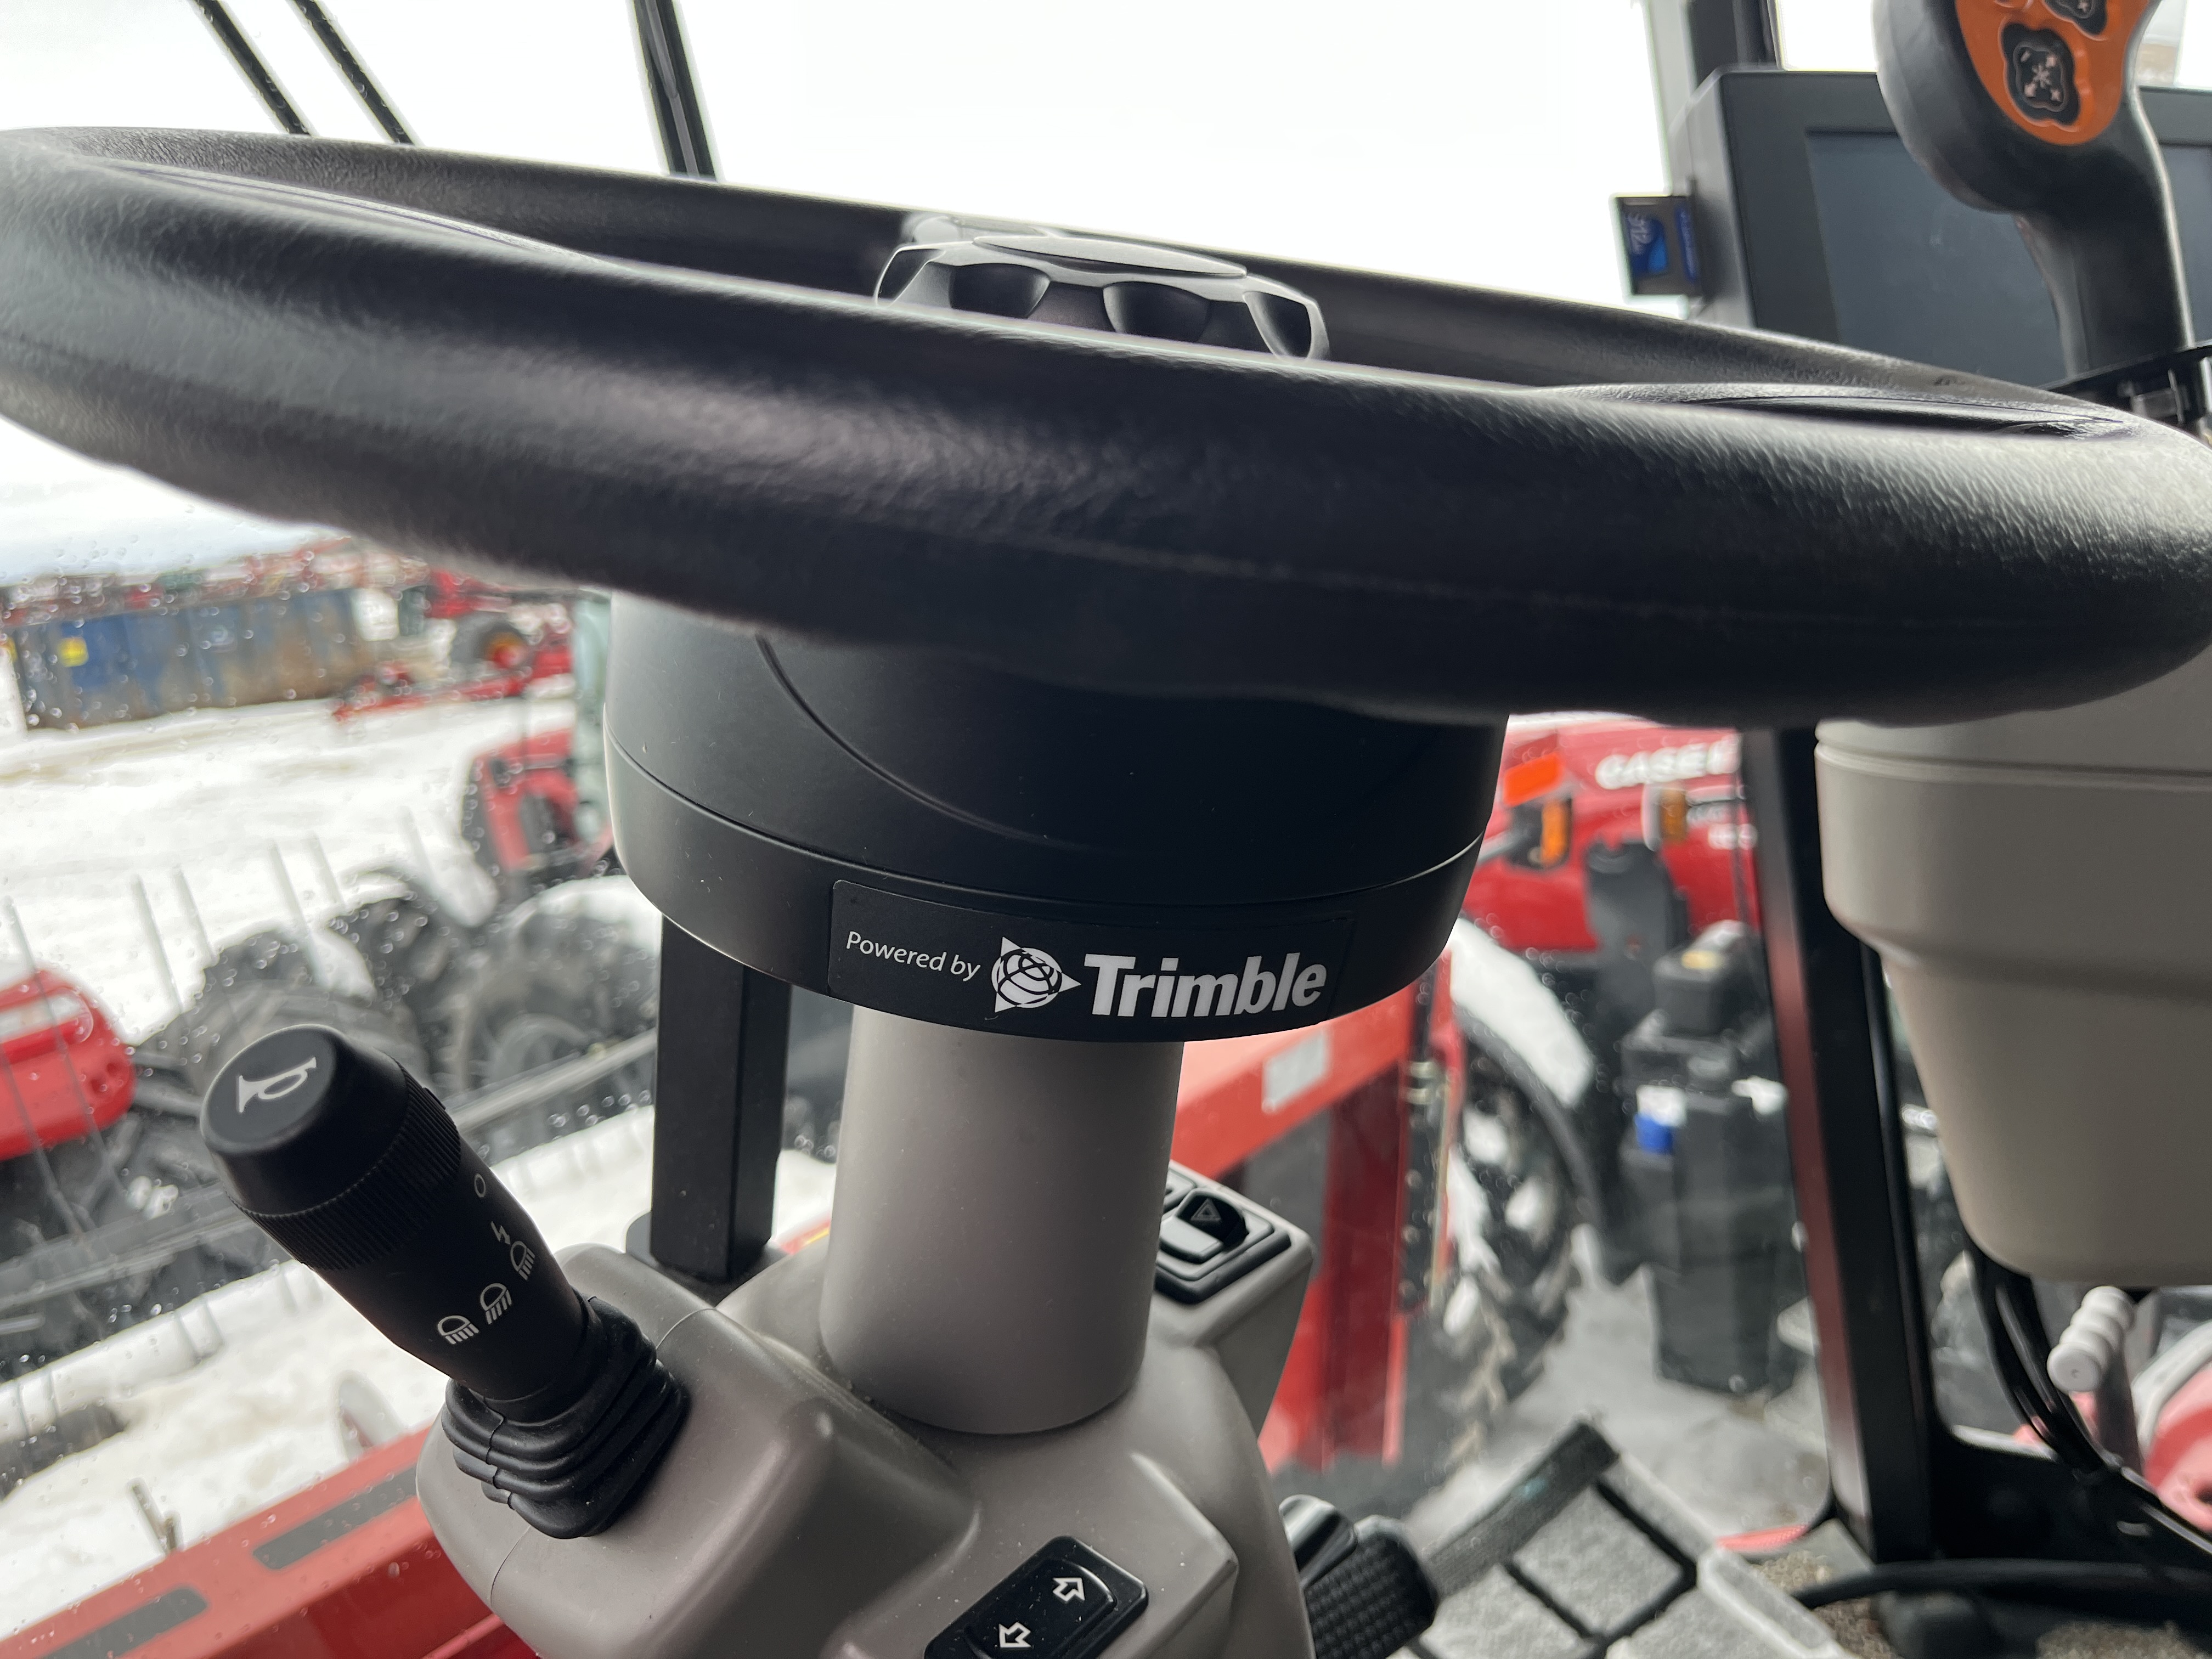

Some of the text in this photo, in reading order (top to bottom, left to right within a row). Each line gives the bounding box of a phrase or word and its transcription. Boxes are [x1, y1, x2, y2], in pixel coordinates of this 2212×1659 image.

[845, 930, 1327, 1018] Powered by Trimble
